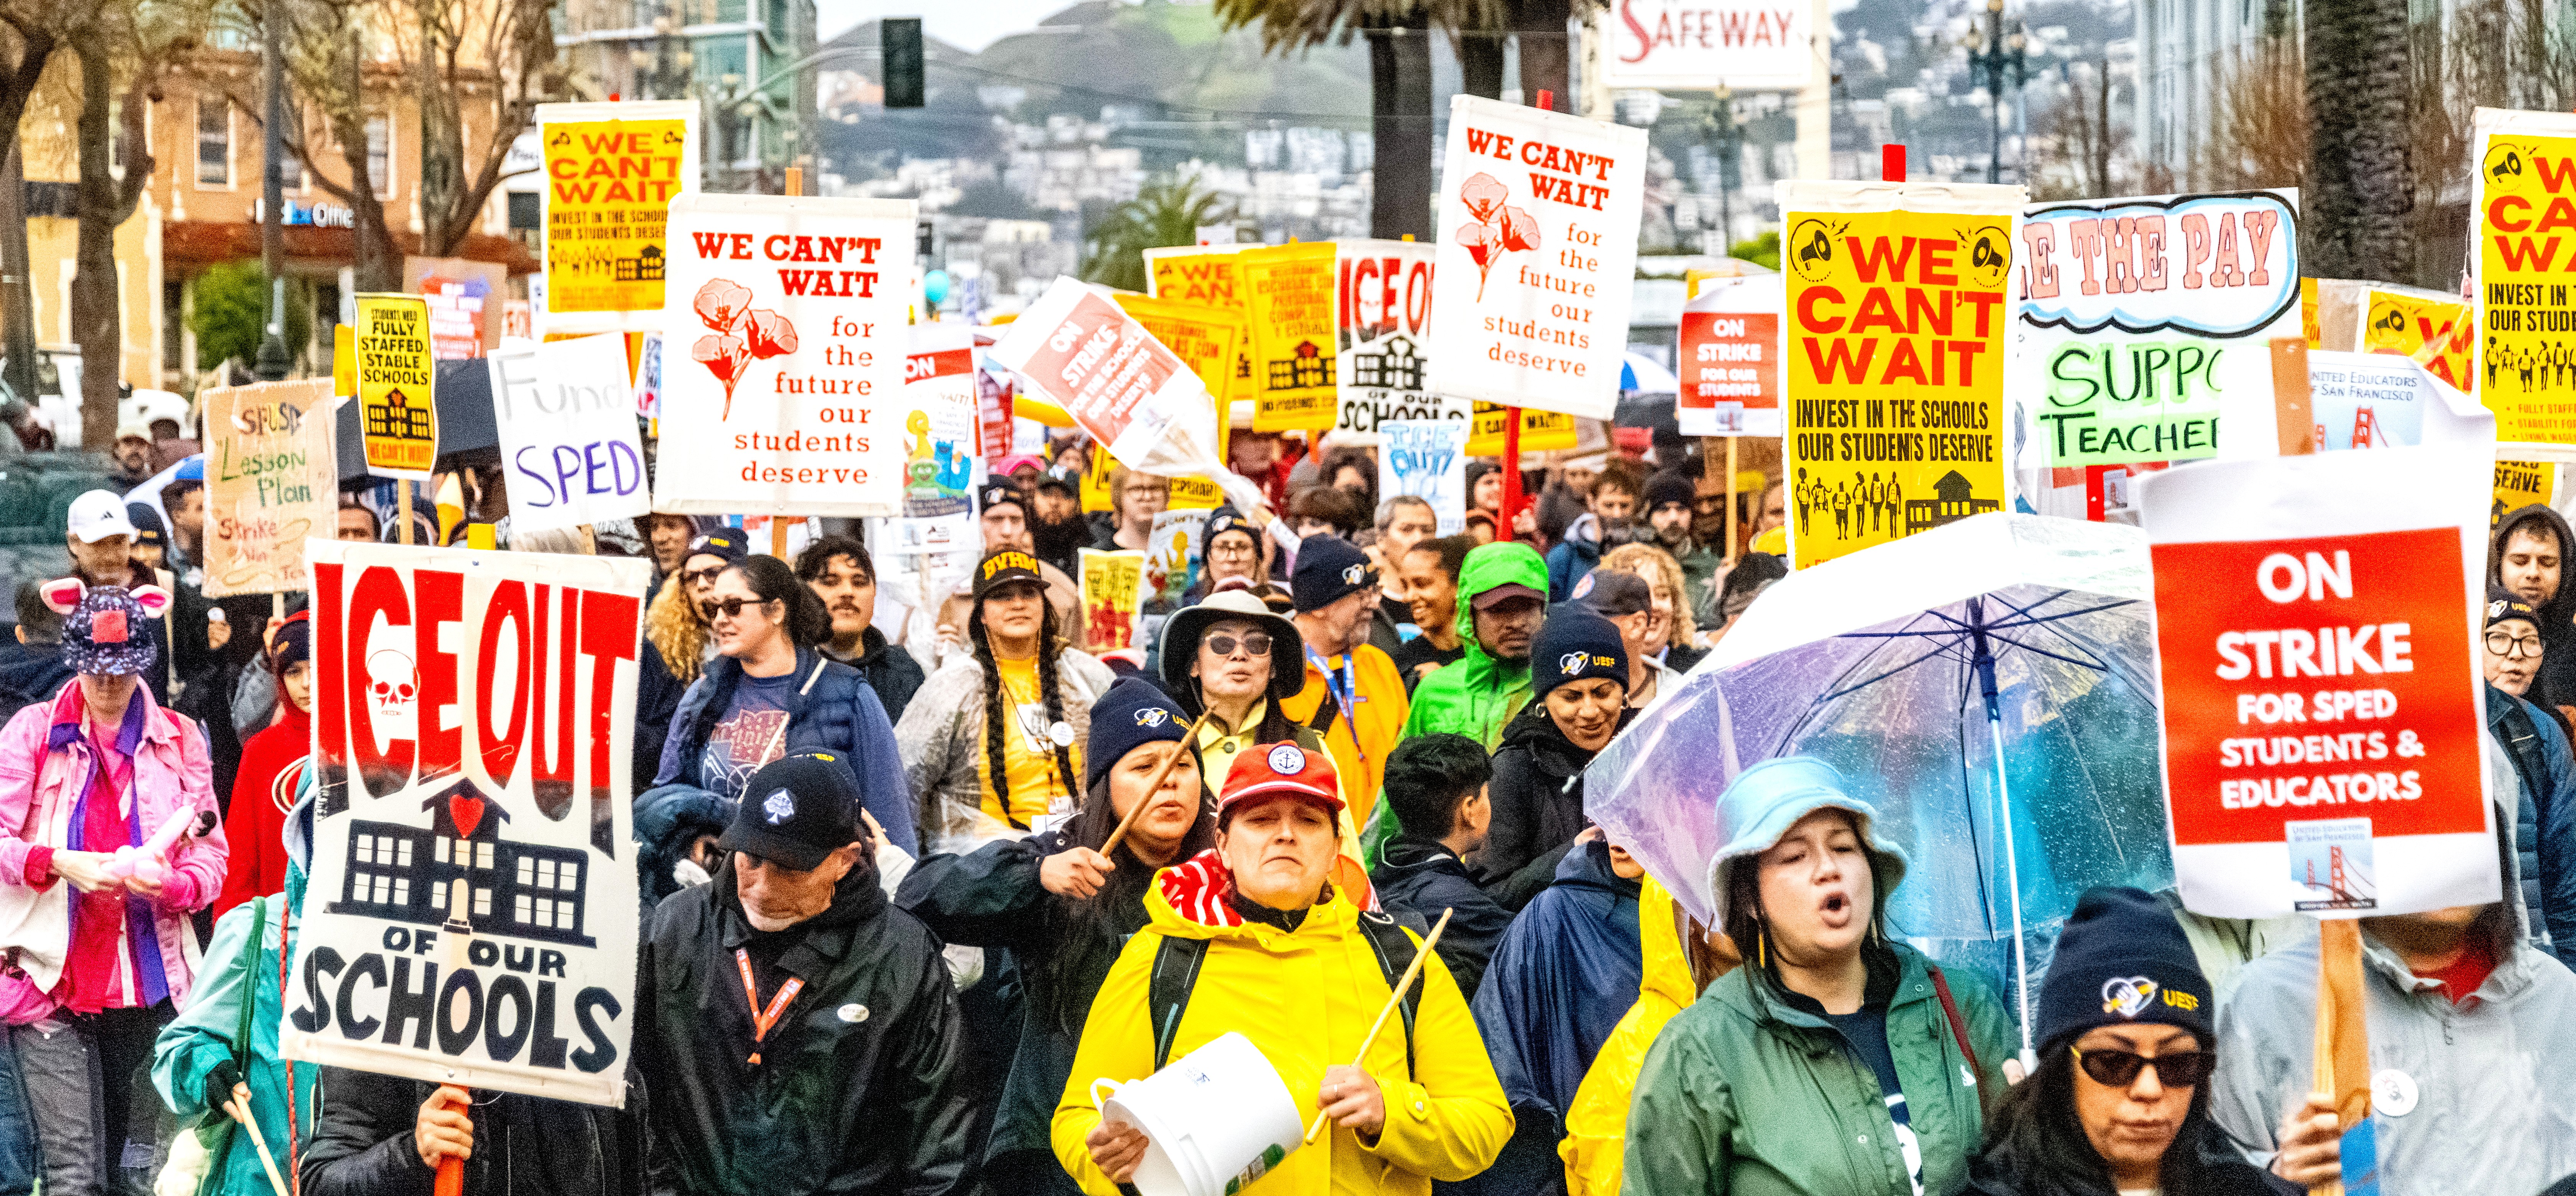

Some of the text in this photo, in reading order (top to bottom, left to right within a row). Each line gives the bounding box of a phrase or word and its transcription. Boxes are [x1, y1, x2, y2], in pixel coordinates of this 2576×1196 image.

[1618, 0, 1793, 64] SAFEWAY
[581, 133, 653, 155] WE
[1467, 127, 1614, 181] WE CAN'T
[550, 156, 678, 179] CAN'T
[2533, 157, 2576, 194] W
[555, 180, 674, 204] WAIT
[1529, 172, 1610, 211] WAIT
[550, 209, 668, 224] INVEST IN THE SCHOO
[550, 225, 666, 240] OUR STUDENTS DESER
[1567, 223, 1602, 246] for
[692, 232, 881, 265] WE CAN'T
[1560, 249, 1598, 271] the
[1845, 235, 1958, 286] WE
[2021, 209, 2278, 300] E THE PAY
[777, 269, 879, 298] WAIT
[1181, 262, 1232, 281] WE
[1519, 265, 1596, 297] future
[1340, 256, 1401, 353] ICE
[2489, 283, 2567, 307] INVEST IN
[371, 309, 417, 321] STUDENTS NEED
[831, 315, 874, 337] for
[1552, 303, 1594, 323] our
[1796, 286, 2003, 338] CAN'T
[2490, 309, 2576, 332] OUR STUDE
[373, 322, 415, 337] FULLY
[1049, 320, 1084, 353] ON
[1484, 314, 1590, 349] students
[1713, 318, 1745, 337] ON
[366, 353, 420, 368] STABLE
[825, 344, 873, 366] the
[1061, 323, 1120, 388] STRIKE
[1100, 327, 1147, 378] SCHOOLS
[1488, 342, 1586, 377] deserve
[1696, 343, 1763, 361] STRIKE
[1802, 337, 1986, 387] WAIT
[364, 368, 429, 386] SCHOOLS
[497, 352, 623, 421] Fund
[774, 372, 872, 396] future
[1104, 348, 1152, 399] STUDENTS
[1700, 368, 1758, 381] FOR OUR
[2049, 348, 2223, 407] SUPP
[2310, 371, 2418, 388] NITED EDUCATORS
[1110, 371, 1153, 418] DESERVE
[1698, 383, 1761, 397] STUDENTS
[2321, 384, 2414, 401] SAN FRANCISCO
[239, 402, 301, 436] SFUSD
[820, 406, 872, 424] our
[1796, 399, 1988, 430] INVEST IN THE SCHOOLS
[2547, 404, 2576, 415] STAFF
[735, 430, 871, 453] students
[1797, 433, 1993, 462] OUR STUDENTS DESERVE
[2040, 411, 2220, 457] TEACHE
[516, 440, 641, 508] SPED
[741, 461, 868, 483] deserve
[2495, 469, 2542, 494] SERVE
[983, 552, 1040, 581] BVHM
[2256, 550, 2354, 604] ON
[2215, 622, 2414, 681] STRIKE
[313, 562, 640, 861] ICE OUT
[2236, 688, 2399, 725] FOR SPED
[2220, 729, 2426, 768] STUDENTS &
[2221, 772, 2423, 810] EDUCATORS
[383, 926, 567, 978] OF OUR
[290, 945, 623, 1073] SCHOOLS
